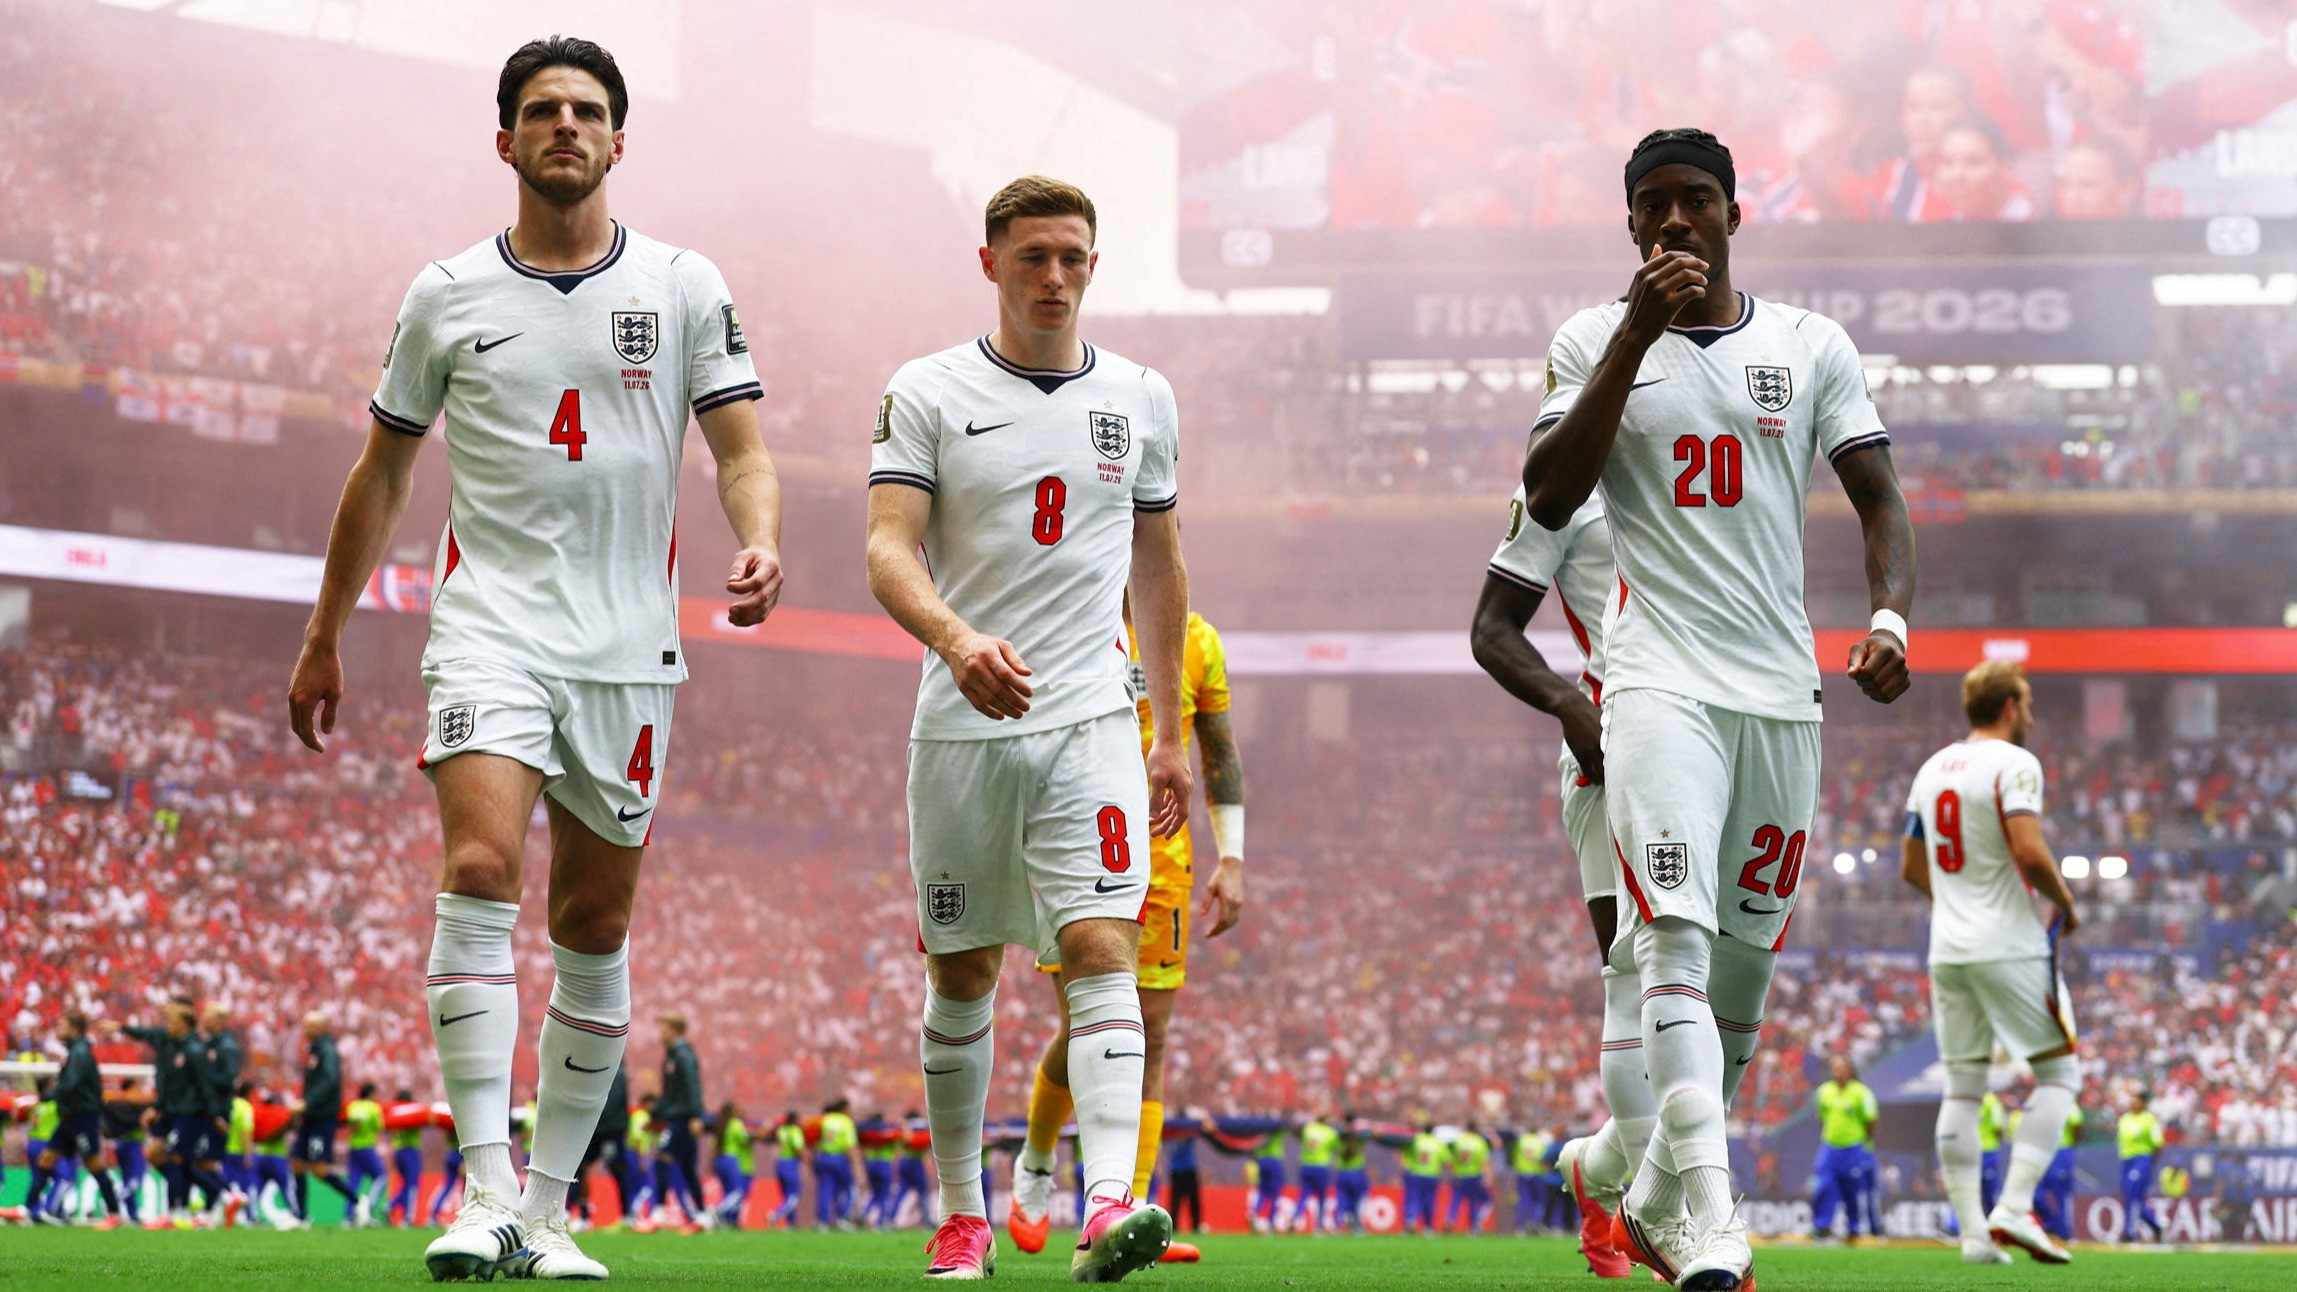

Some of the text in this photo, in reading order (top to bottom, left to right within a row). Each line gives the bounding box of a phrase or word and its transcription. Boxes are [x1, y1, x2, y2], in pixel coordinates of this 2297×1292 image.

[1413, 296, 1534, 337] FIFA
[1872, 287, 2072, 333] 2026
[621, 369, 652, 379] NORWAY
[549, 389, 587, 461] 4
[1757, 416, 1787, 428] NORWAY
[1097, 462, 1125, 475] NORWAY
[1673, 434, 1743, 507] 20
[1032, 476, 1068, 546] 8
[627, 724, 654, 798] 4
[1097, 805, 1131, 873] 8
[1737, 824, 1807, 899] 20
[1935, 789, 1966, 873] 9
[1171, 906, 1181, 953] 1
